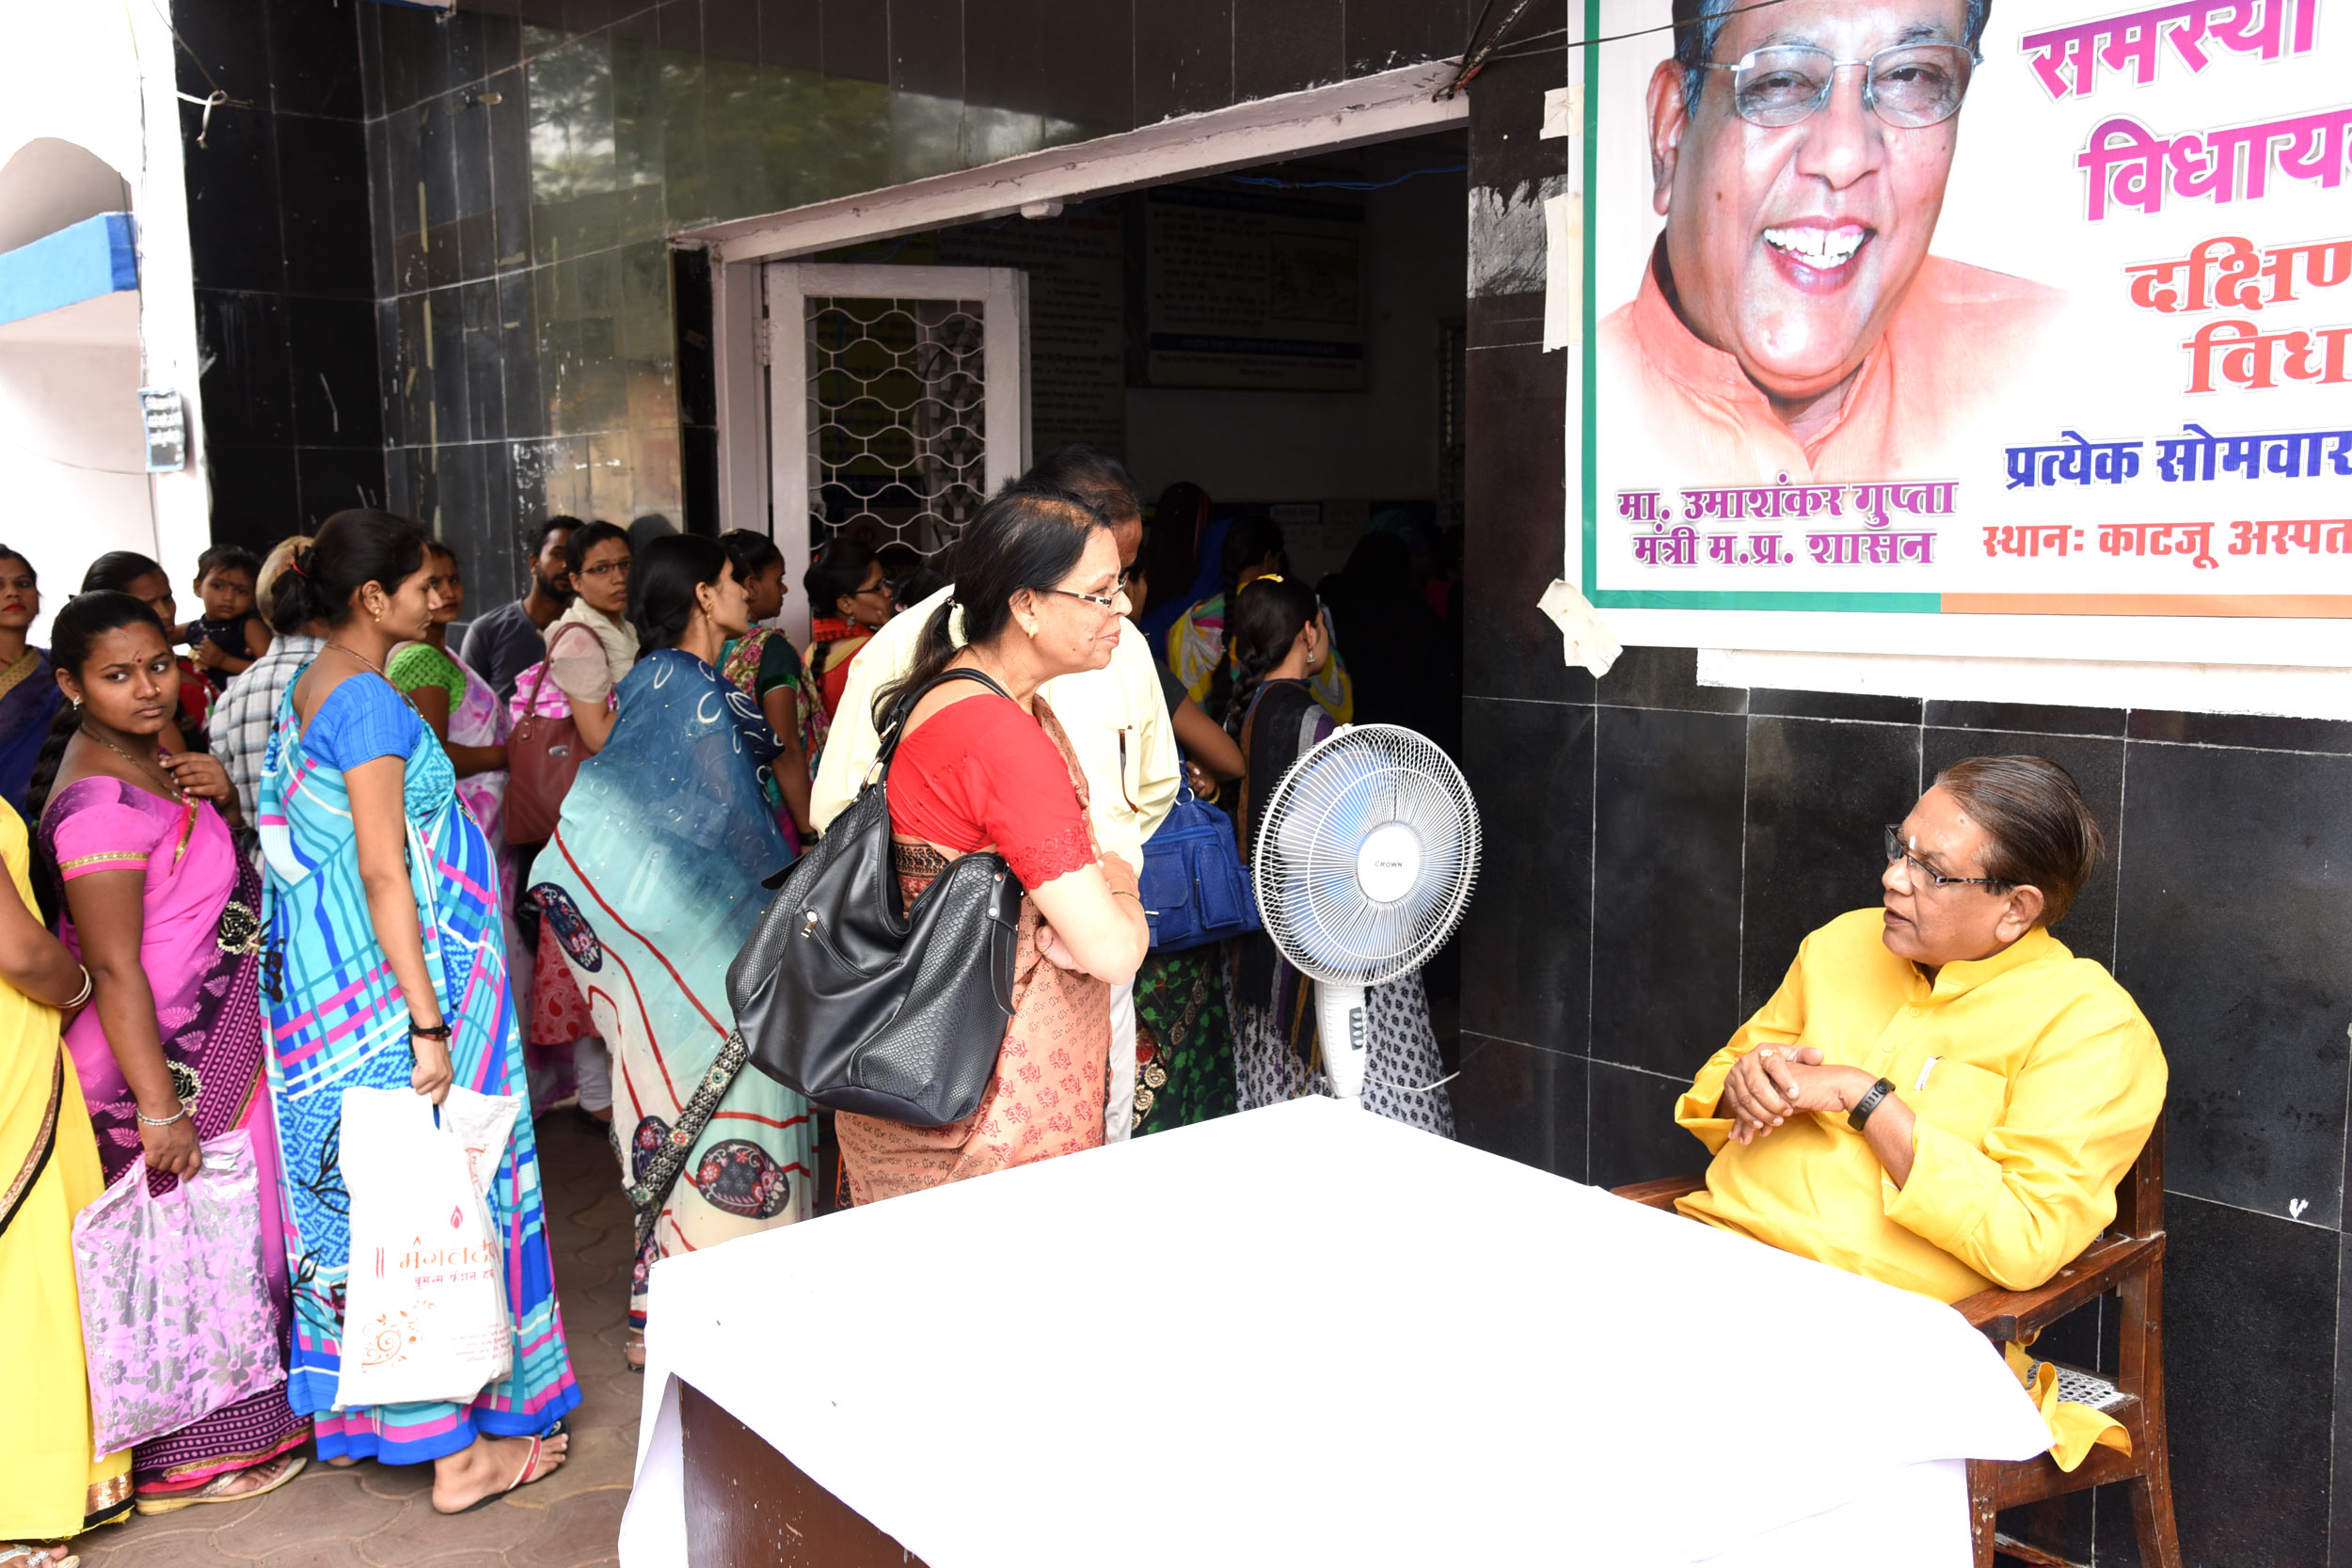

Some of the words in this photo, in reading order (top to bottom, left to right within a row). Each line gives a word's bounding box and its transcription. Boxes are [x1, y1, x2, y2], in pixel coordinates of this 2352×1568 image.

[2078, 119, 2352, 221] विधाय
[2006, 430, 2143, 490] प्रत्येक
[2156, 423, 2352, 482] सोमवार
[1618, 493, 1671, 521] मा.
[1680, 473, 1847, 520] उमाशंकर
[1852, 482, 1960, 527] गुप्ता
[1634, 523, 1699, 564] मंत्री
[1805, 532, 1937, 564] शासन
[2098, 522, 2219, 569] काटजू
[1375, 860, 1403, 868] CROWN
